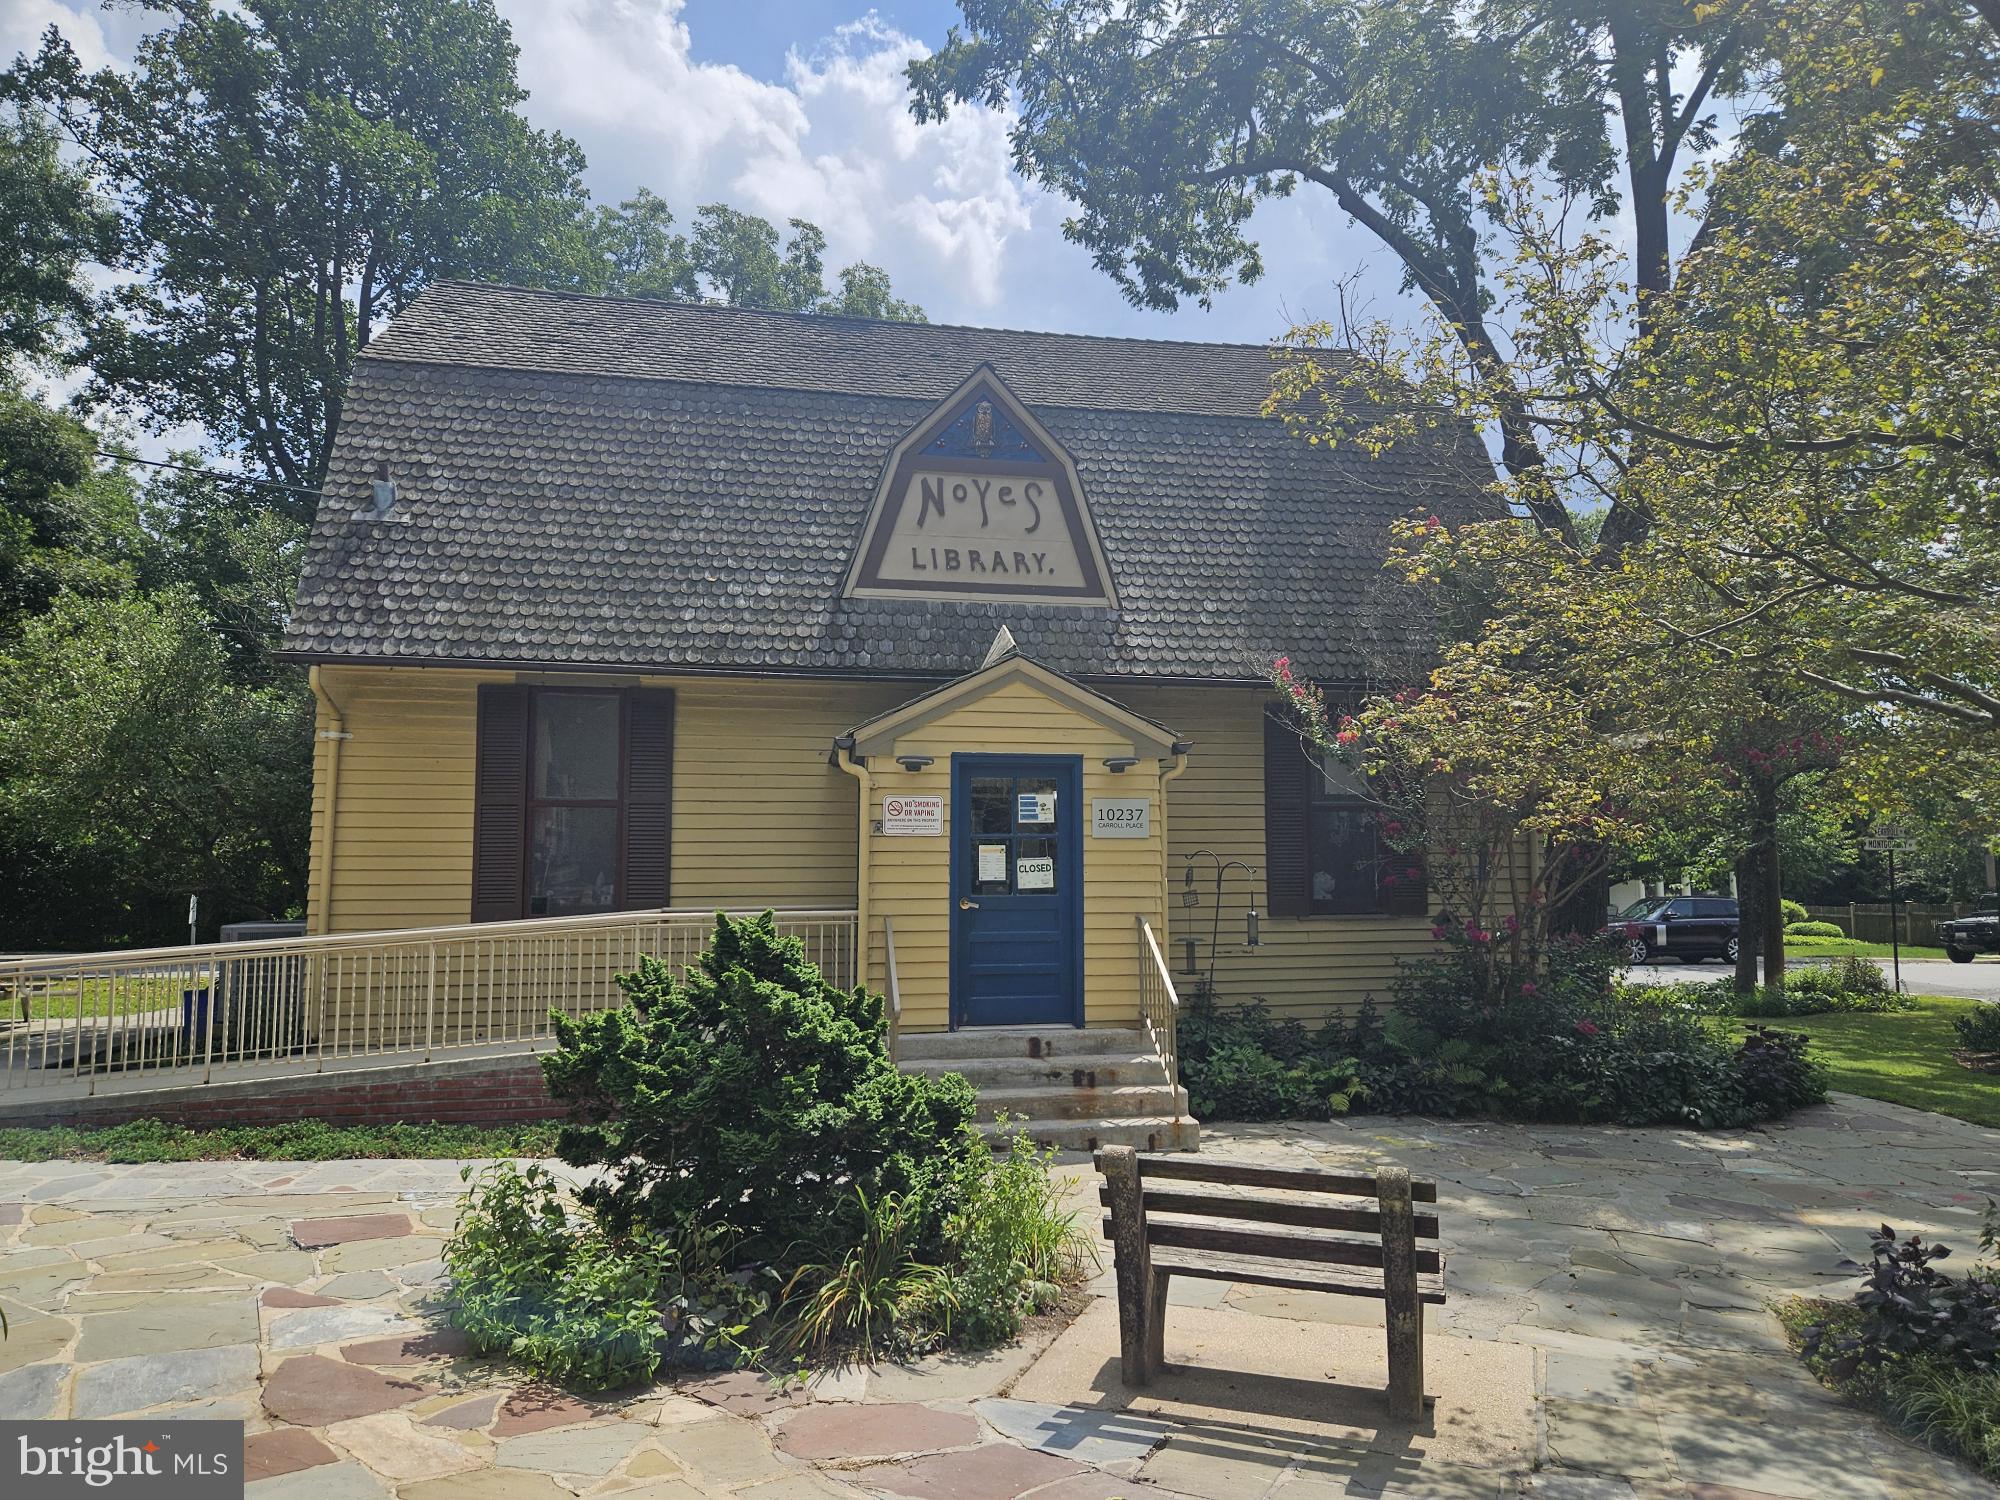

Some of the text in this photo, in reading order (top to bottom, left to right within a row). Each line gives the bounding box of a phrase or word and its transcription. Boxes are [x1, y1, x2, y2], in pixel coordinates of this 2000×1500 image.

[911, 547, 1055, 575] LIBRARY.
[1098, 808, 1144, 821] 10237
[1019, 864, 1052, 873] CLOSED
